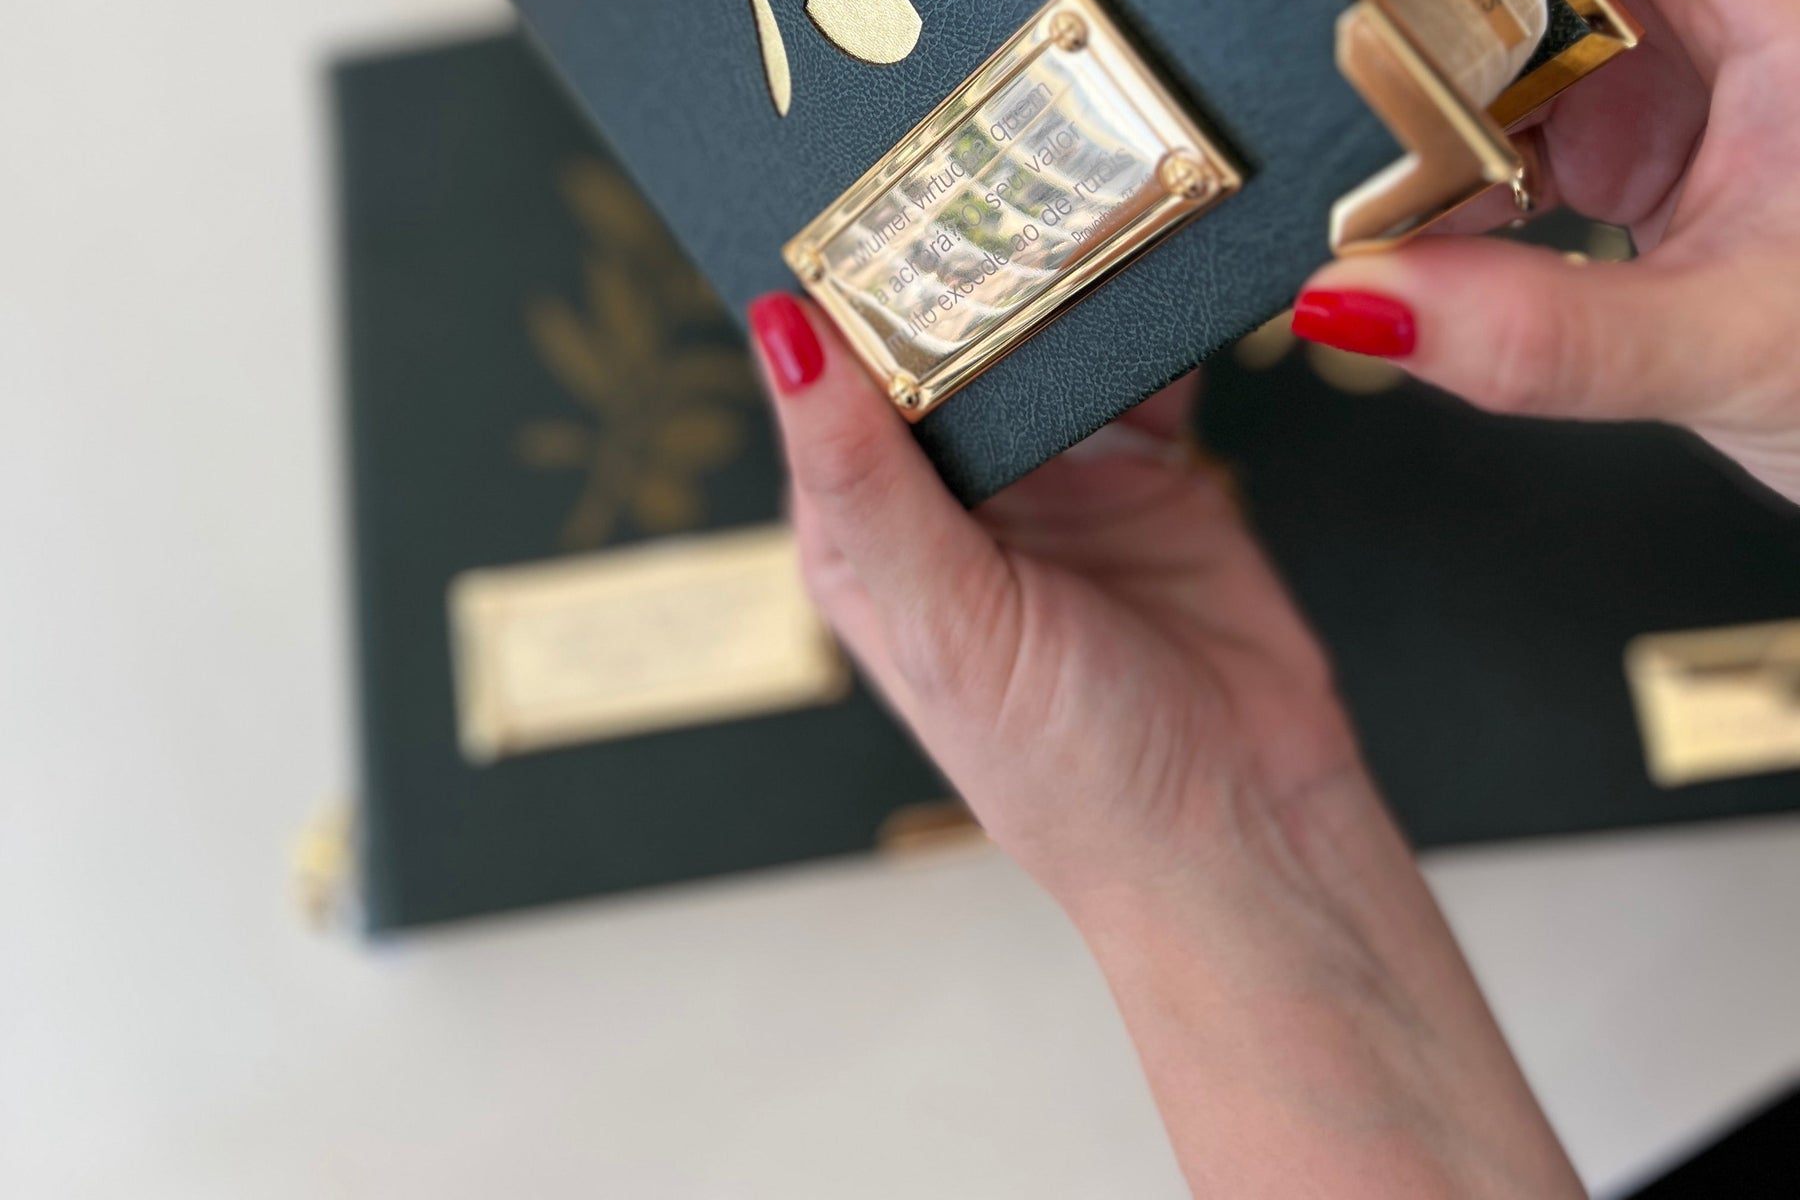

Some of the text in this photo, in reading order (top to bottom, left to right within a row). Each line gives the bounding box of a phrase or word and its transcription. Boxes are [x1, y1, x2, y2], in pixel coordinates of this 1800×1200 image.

[990, 82, 1053, 142] quem
[962, 203, 982, 227] O
[985, 174, 1024, 210] seu
[1025, 121, 1080, 173] valor
[938, 247, 1009, 311] excede
[1010, 224, 1039, 257] ao
[1041, 197, 1072, 227] de
